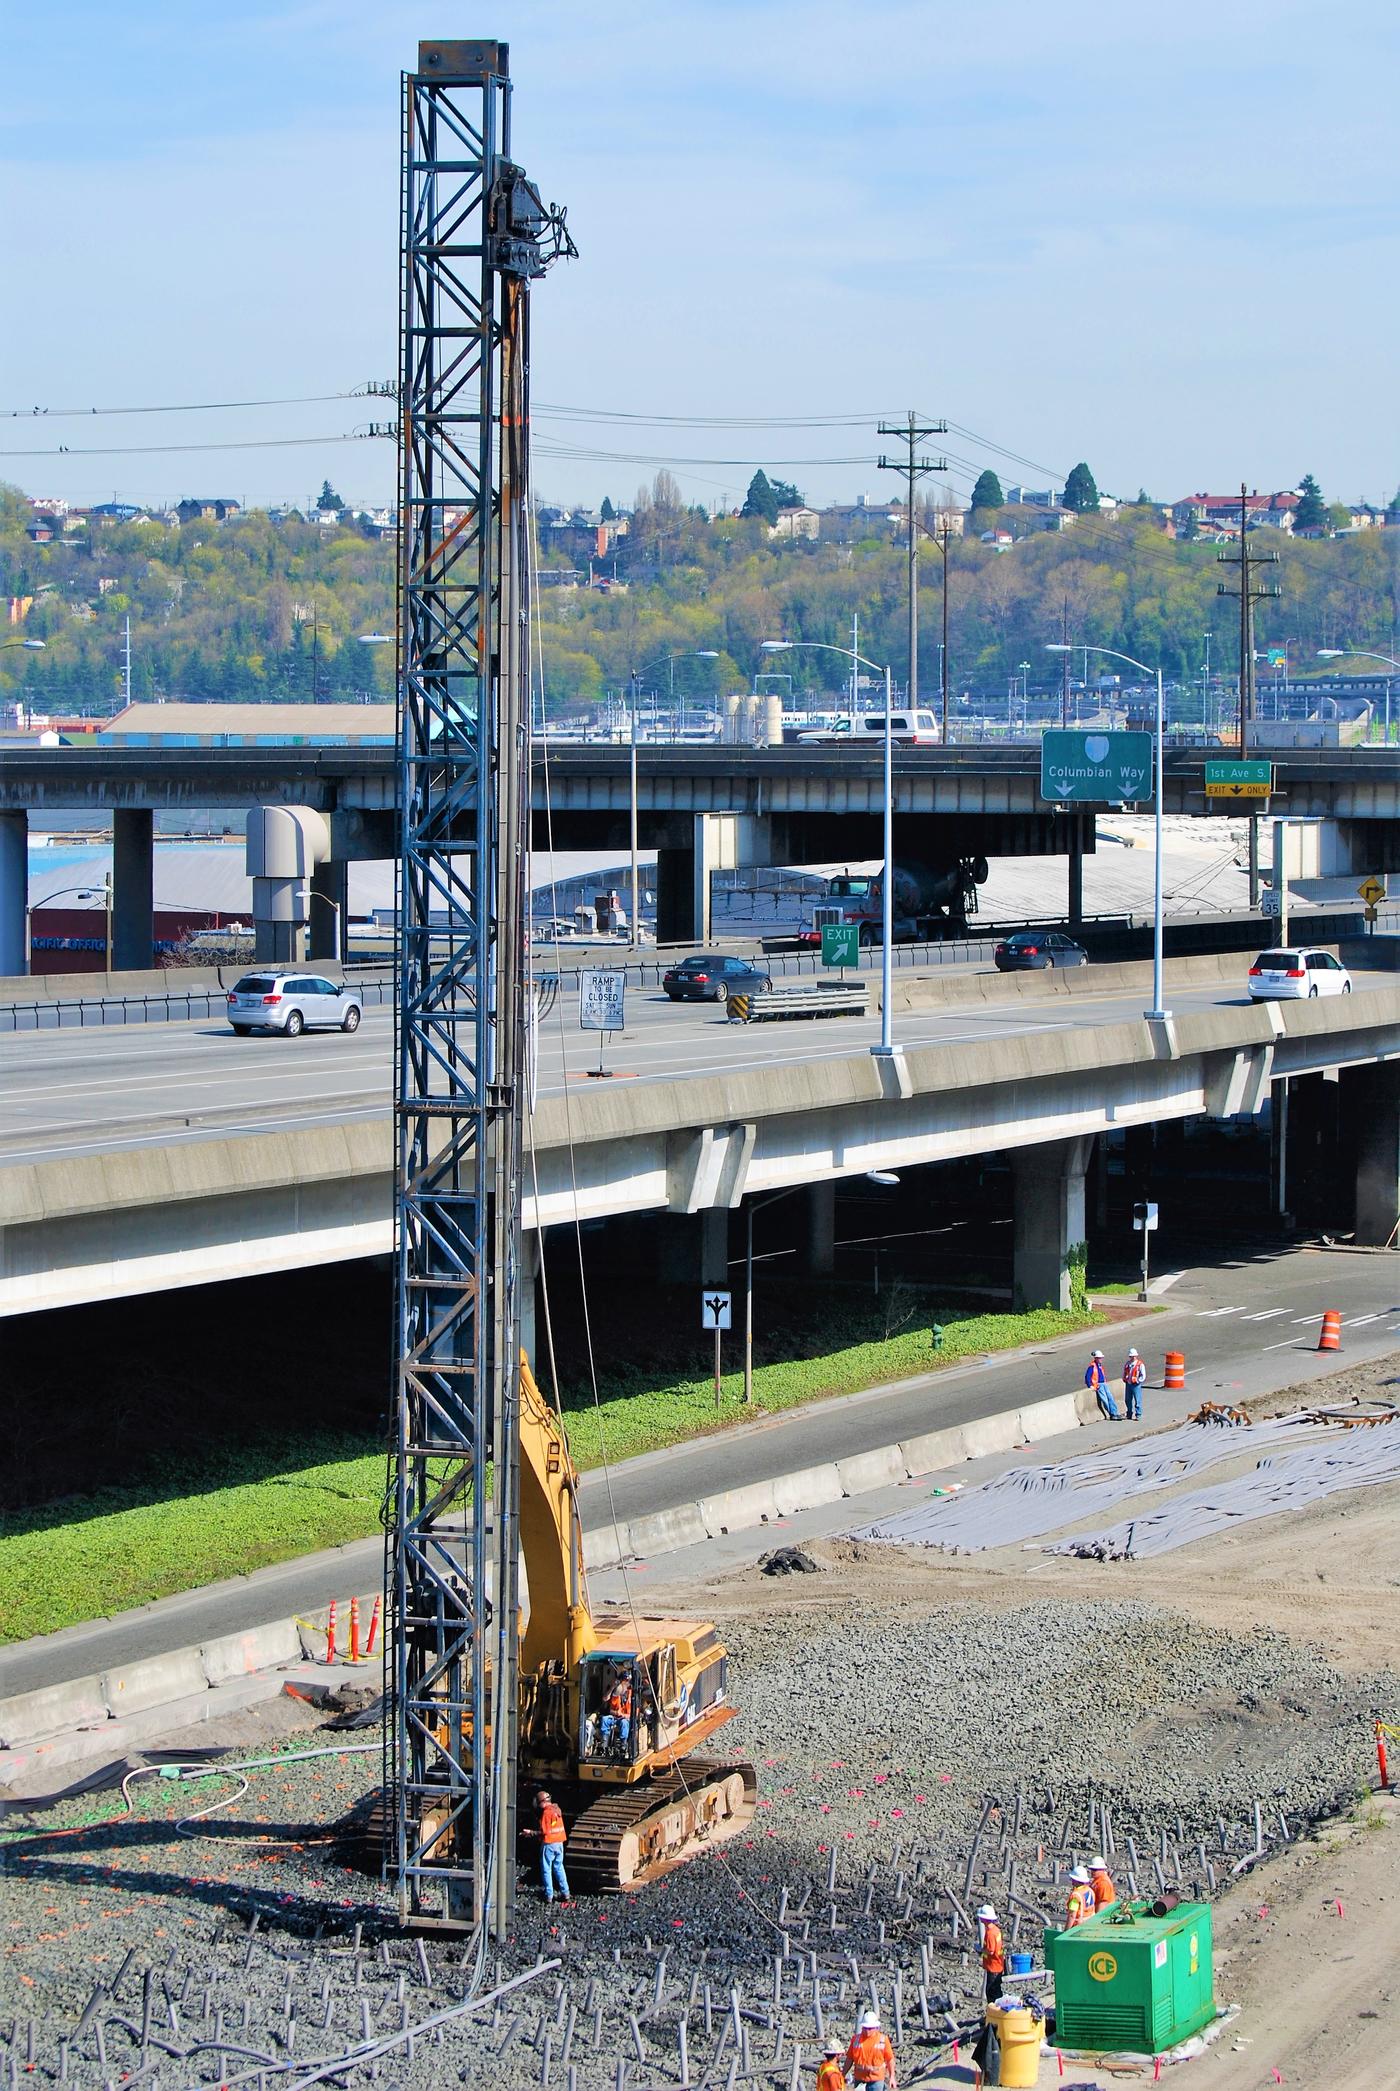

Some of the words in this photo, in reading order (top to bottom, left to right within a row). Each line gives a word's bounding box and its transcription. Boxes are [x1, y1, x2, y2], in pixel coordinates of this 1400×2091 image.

[1048, 766, 1112, 778] Columbian
[1120, 766, 1145, 781] Way
[1211, 768, 1225, 778] 1st
[1231, 768, 1249, 778] Ave
[1257, 768, 1266, 778] S.
[1208, 786, 1226, 794] EXIT
[1247, 786, 1267, 794] ONLY
[1265, 903, 1279, 914] 35
[826, 929, 854, 940] EXIT
[592, 977, 615, 986] RAMP
[588, 993, 619, 1002] CLOSED
[1090, 1957, 1115, 1976] ICE
